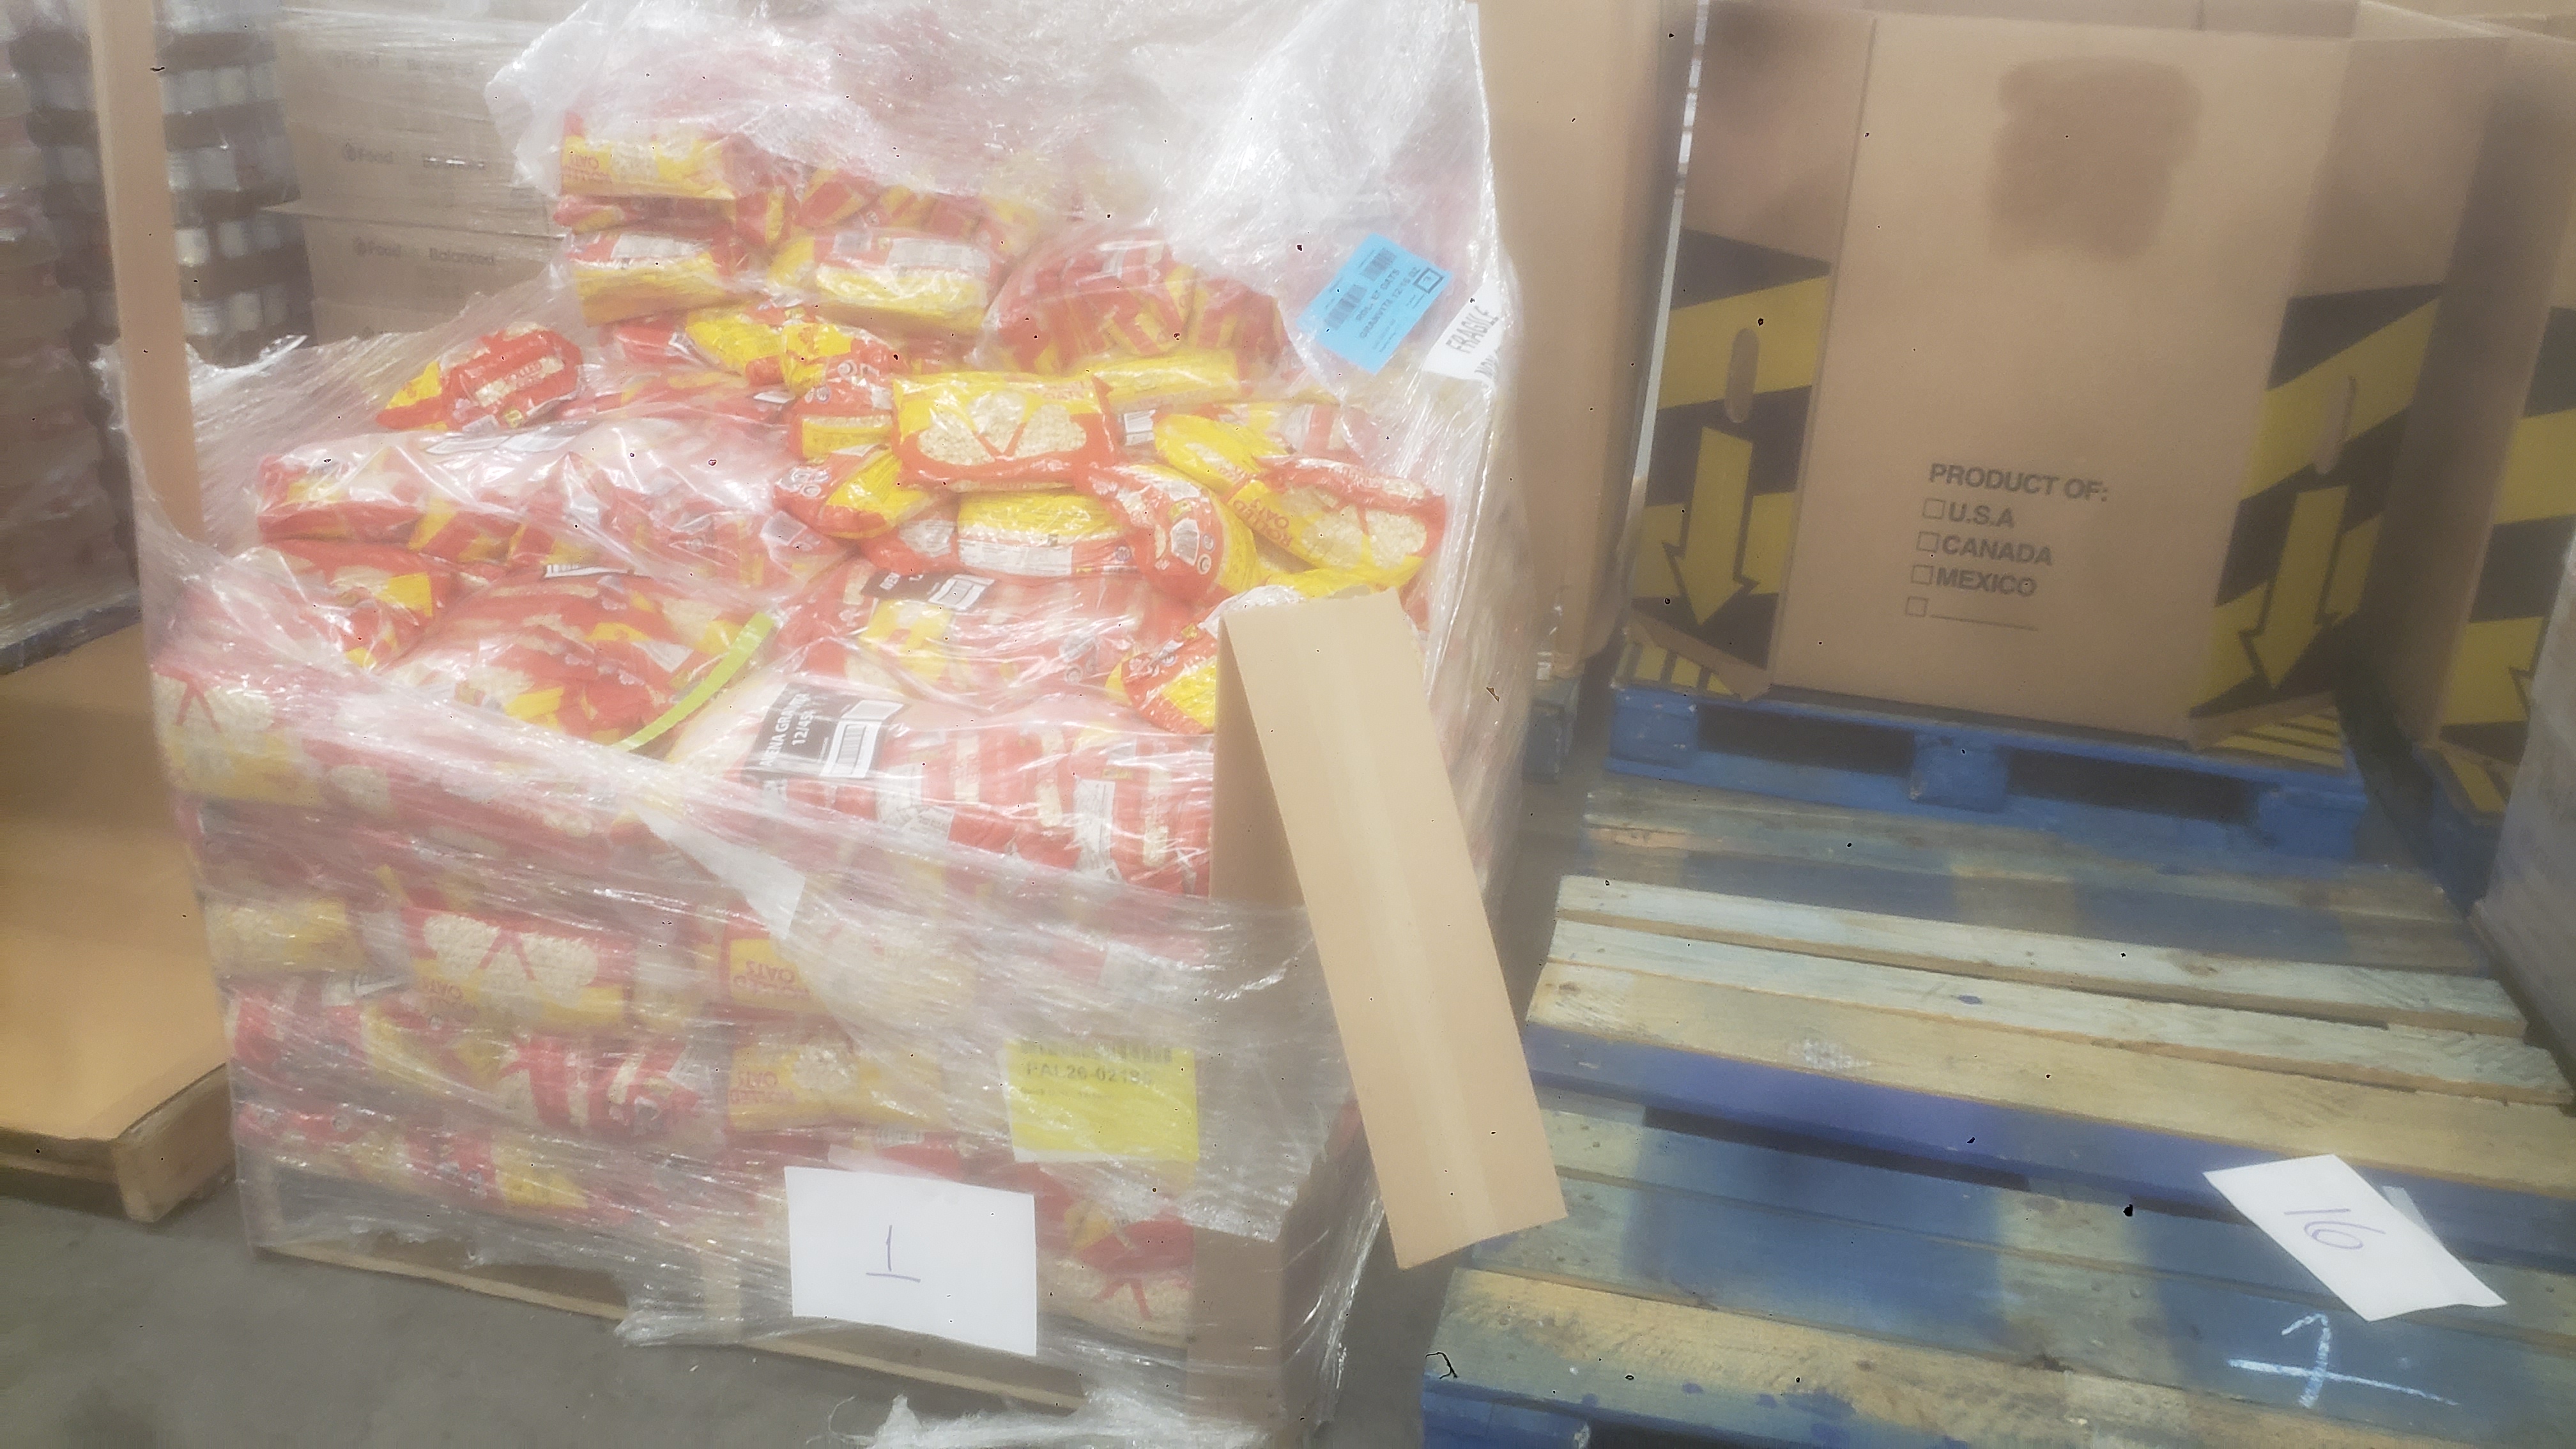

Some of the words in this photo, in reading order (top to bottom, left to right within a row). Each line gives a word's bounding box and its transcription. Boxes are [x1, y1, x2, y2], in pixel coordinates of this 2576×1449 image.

[1445, 305, 1499, 353] FRAGILE
[1929, 463, 2058, 496] PRODUCT
[2064, 477, 2108, 502] OF:
[1949, 502, 2015, 528] U.S.A
[1942, 535, 2053, 565] CANADA
[1936, 567, 2037, 597] MEXICO
[2283, 1207, 2387, 1251] 16
